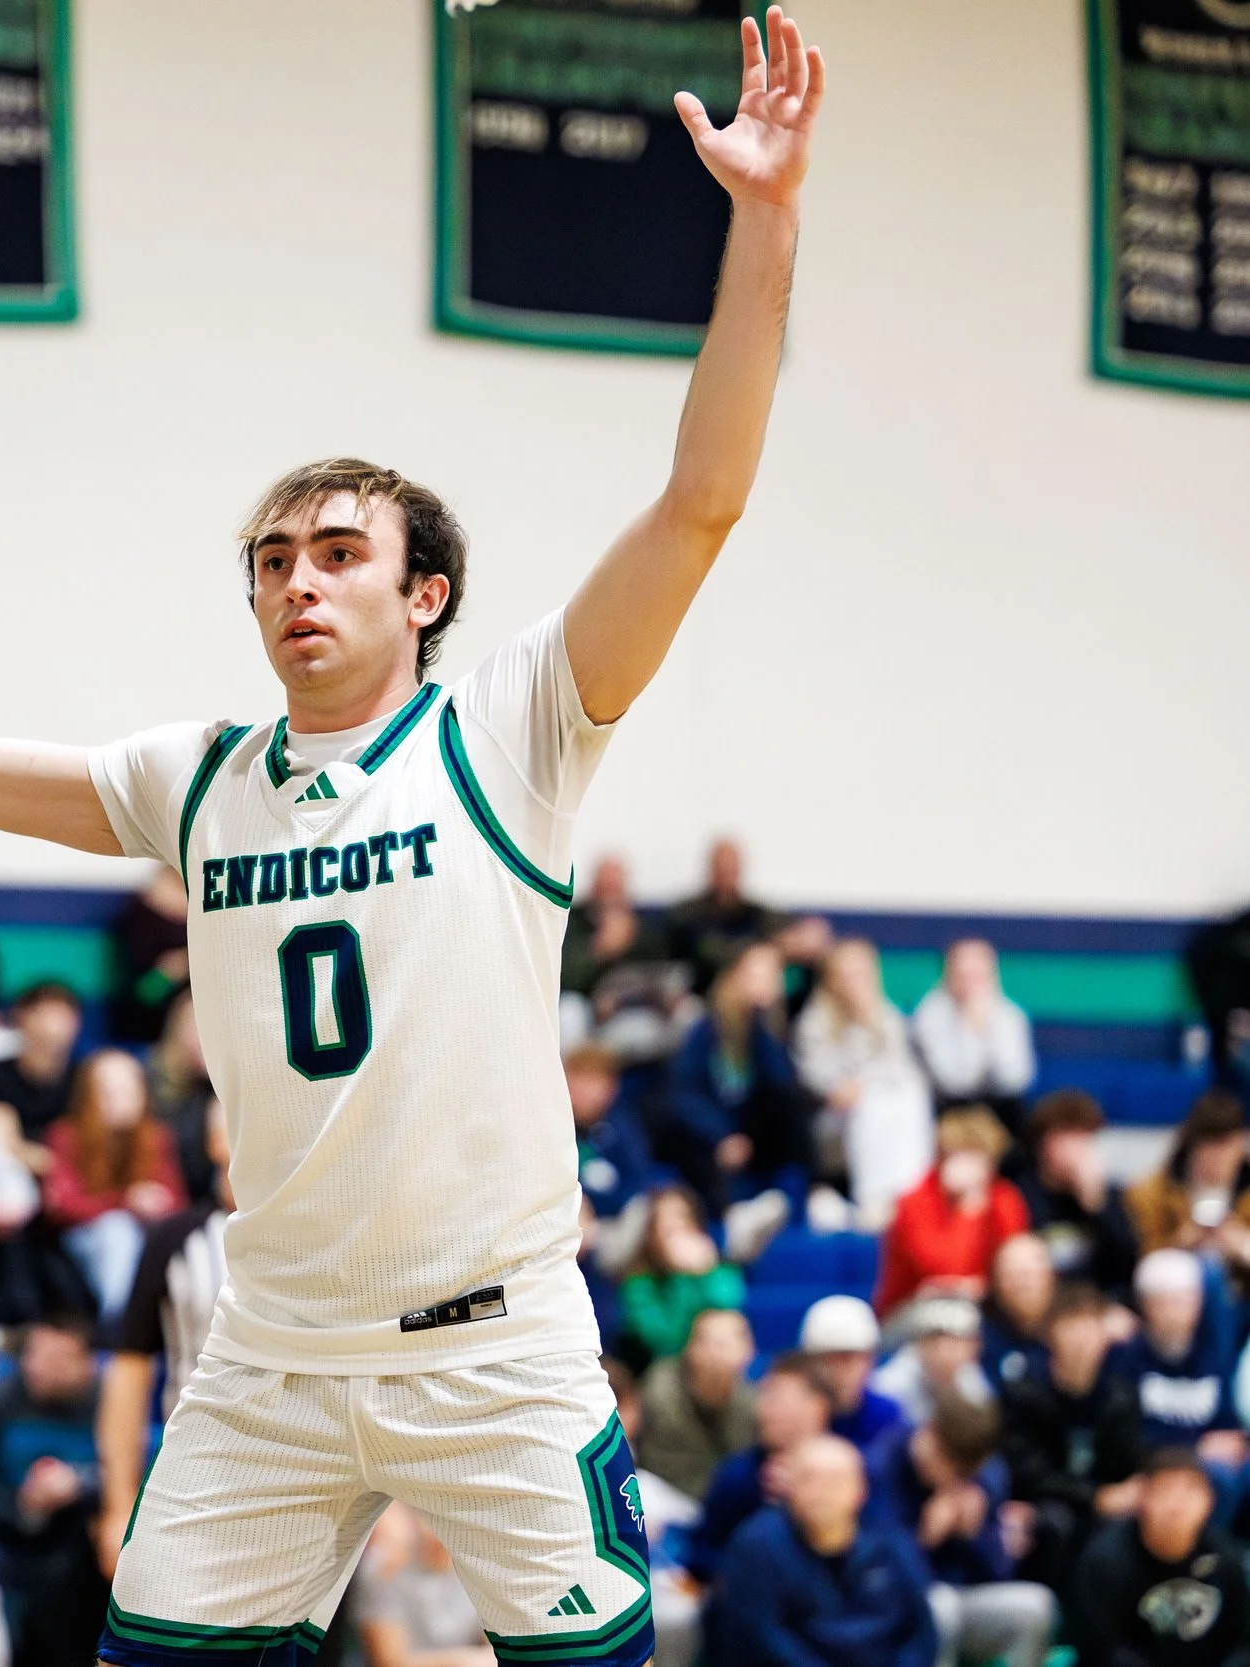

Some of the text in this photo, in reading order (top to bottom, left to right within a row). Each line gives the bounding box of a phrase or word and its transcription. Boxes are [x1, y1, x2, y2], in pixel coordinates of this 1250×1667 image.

[202, 822, 439, 914] ENDICOTT
[277, 919, 373, 1082] 0
[449, 1306, 458, 1318] M
